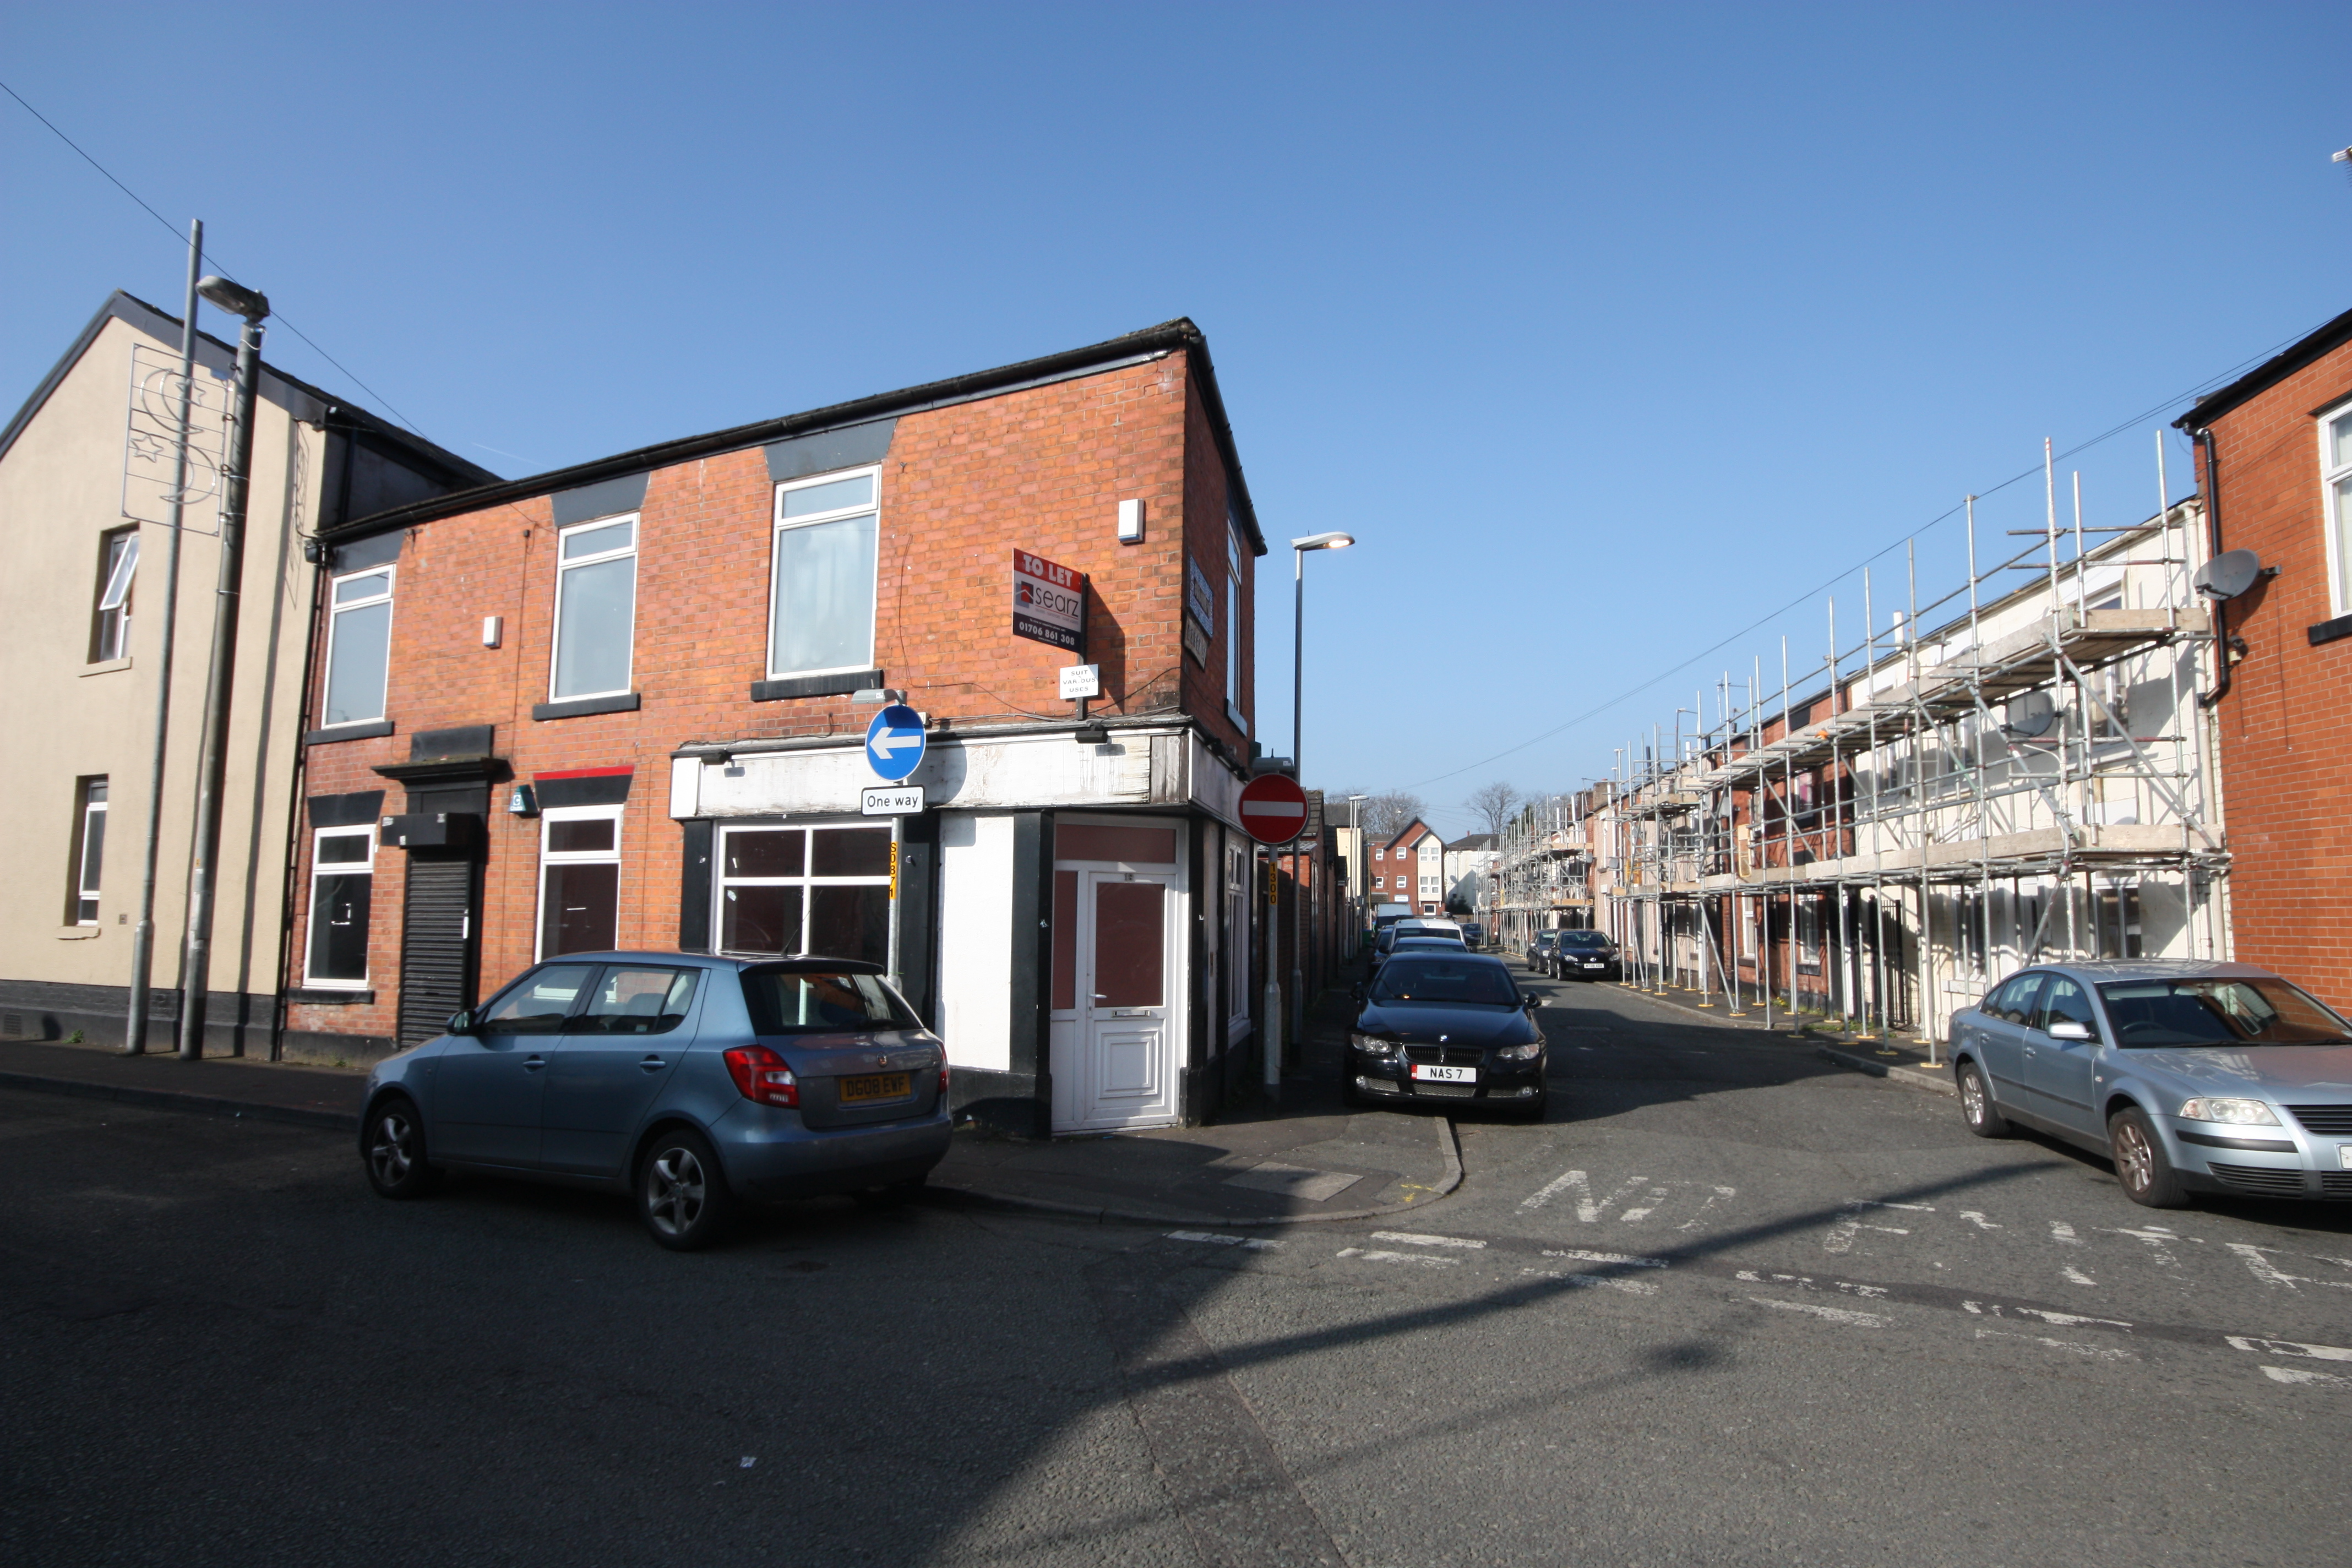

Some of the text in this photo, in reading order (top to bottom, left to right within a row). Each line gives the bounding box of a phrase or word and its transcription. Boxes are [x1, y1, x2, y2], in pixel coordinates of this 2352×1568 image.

[1023, 554, 1073, 587] TO LET
[1035, 587, 1079, 618] searz
[1019, 621, 1043, 636] 01706
[1044, 629, 1058, 641] 861
[1060, 634, 1075, 646] 308
[867, 795, 919, 808] One way
[1430, 1068, 1463, 1079] NAS 7
[847, 1078, 880, 1096] DG08
